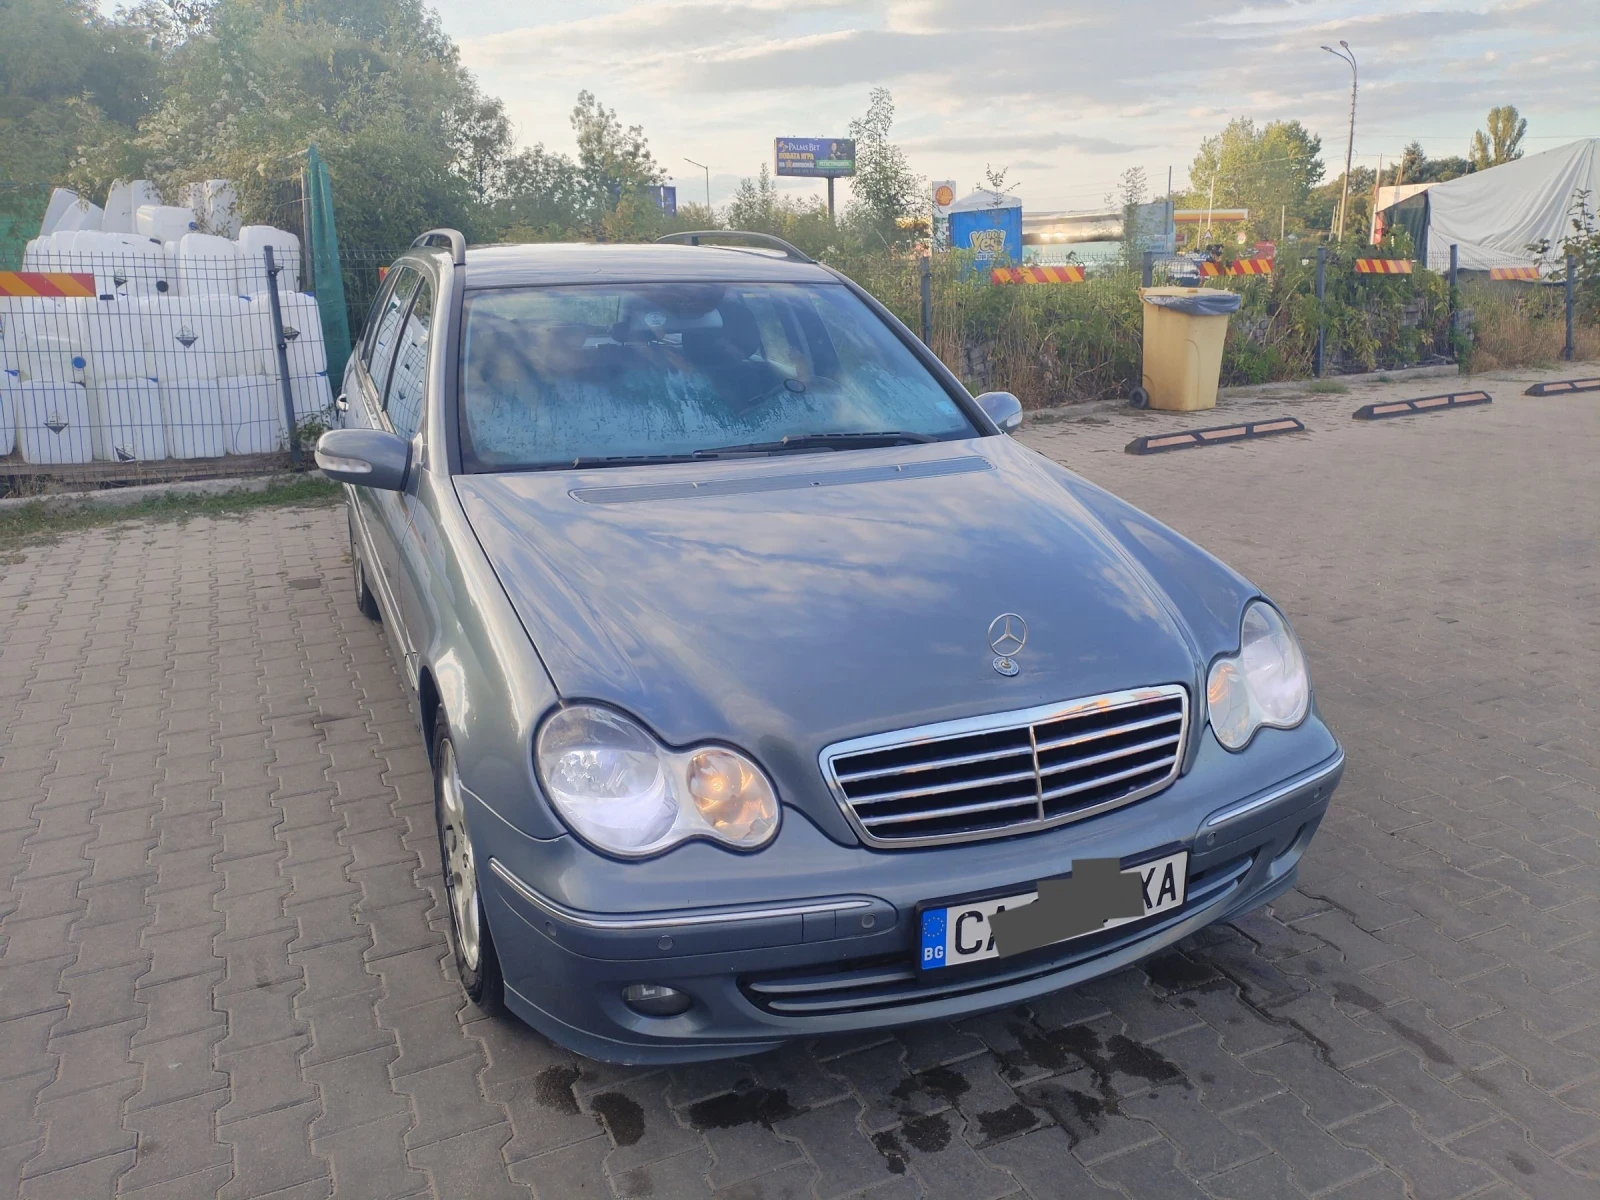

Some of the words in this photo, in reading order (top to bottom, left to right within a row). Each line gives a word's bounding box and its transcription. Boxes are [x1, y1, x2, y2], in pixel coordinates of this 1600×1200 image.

[788, 143, 808, 151] PALMS
[809, 143, 820, 151] BET
[924, 945, 943, 961] BG
